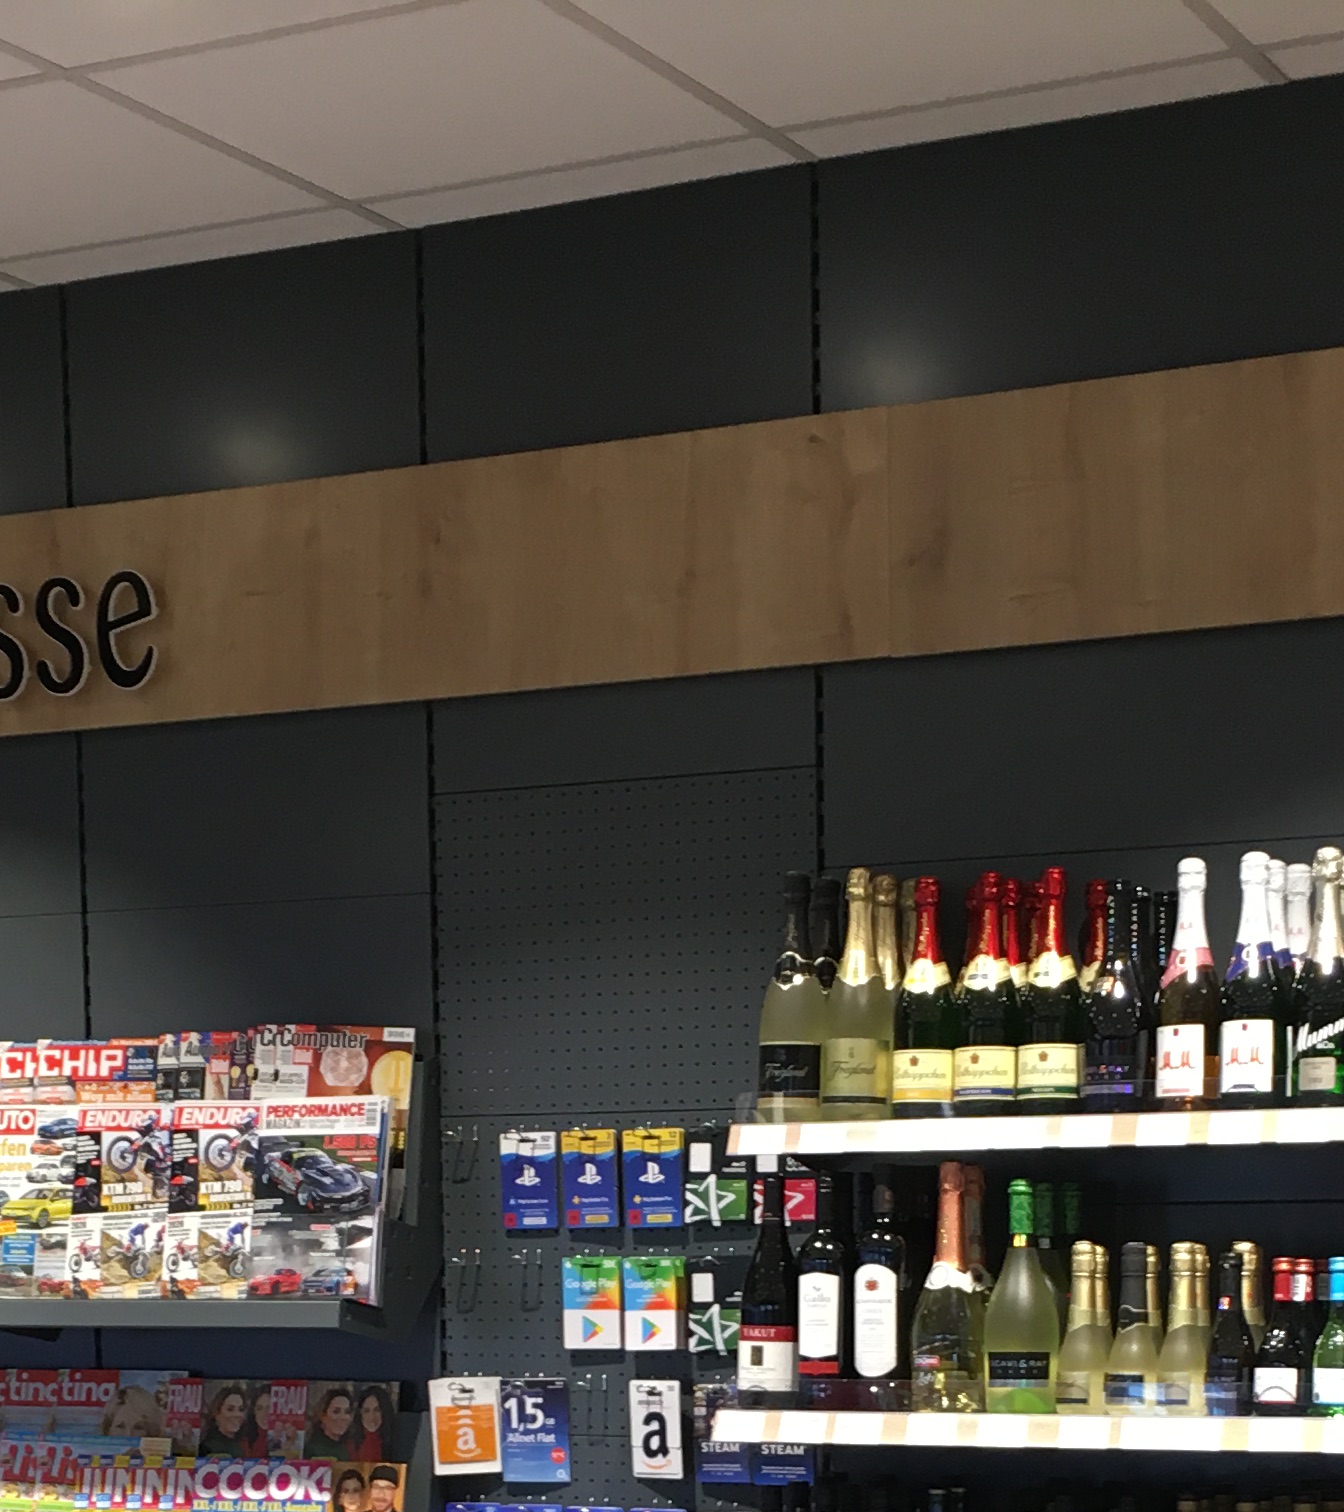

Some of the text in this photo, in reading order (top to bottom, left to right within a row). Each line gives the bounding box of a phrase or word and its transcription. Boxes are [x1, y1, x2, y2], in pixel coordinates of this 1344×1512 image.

[280, 1028, 367, 1052] Computer
[37, 1049, 123, 1080] CHIP
[266, 1102, 365, 1118] PERFORMANCE
[168, 1383, 203, 1413] FRAU
[270, 1384, 308, 1414] FRAU
[504, 1397, 545, 1431] 1,5
[701, 1441, 740, 1453] STEAM
[761, 1444, 805, 1456] STEAM
[269, 1464, 331, 1502] OK!
